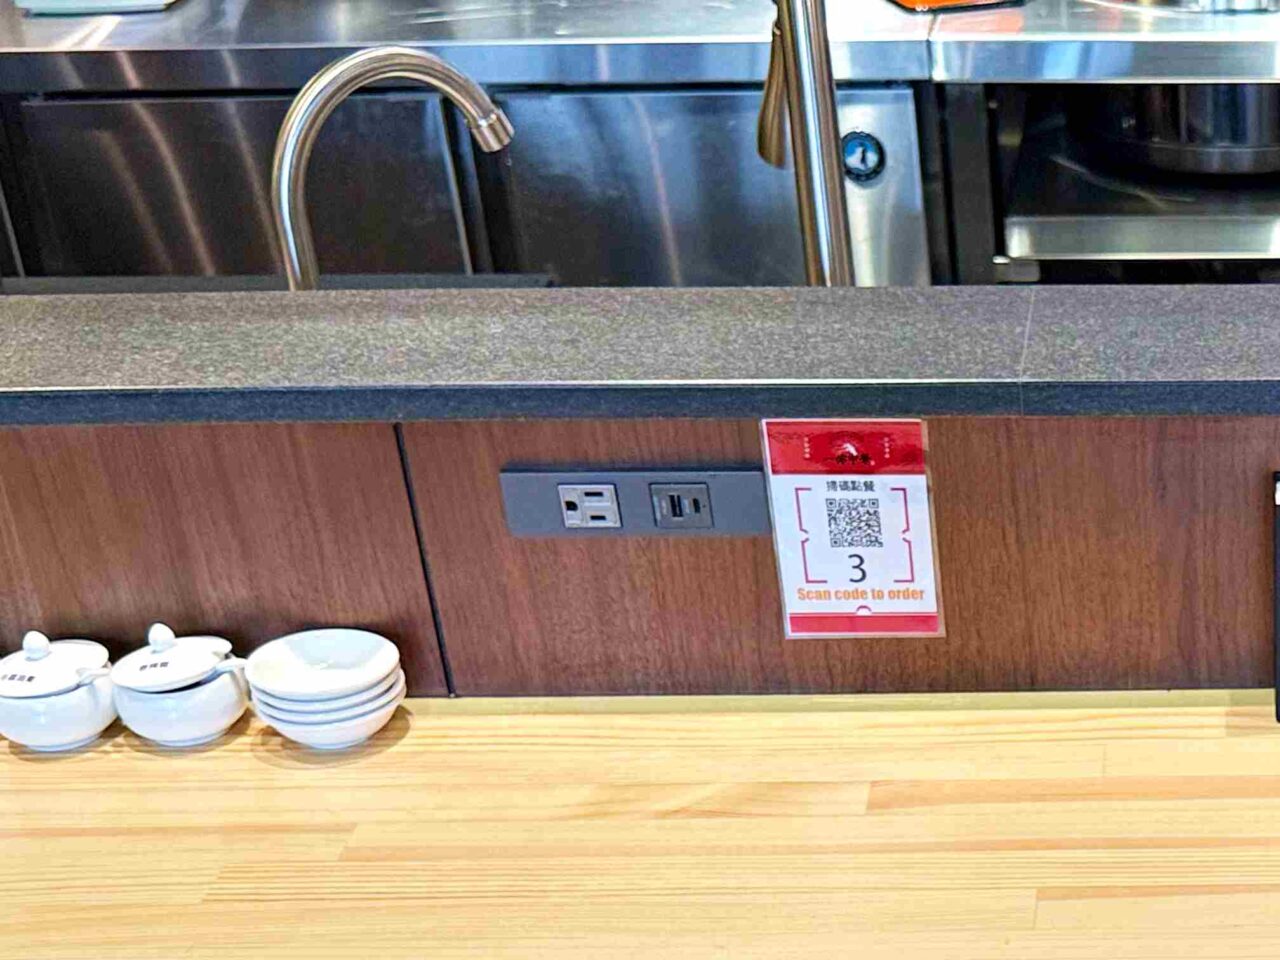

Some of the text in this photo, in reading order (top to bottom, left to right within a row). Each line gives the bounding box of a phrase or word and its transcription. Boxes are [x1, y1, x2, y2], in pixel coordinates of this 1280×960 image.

[847, 553, 867, 583] 3
[797, 588, 925, 600] Scan code to order
